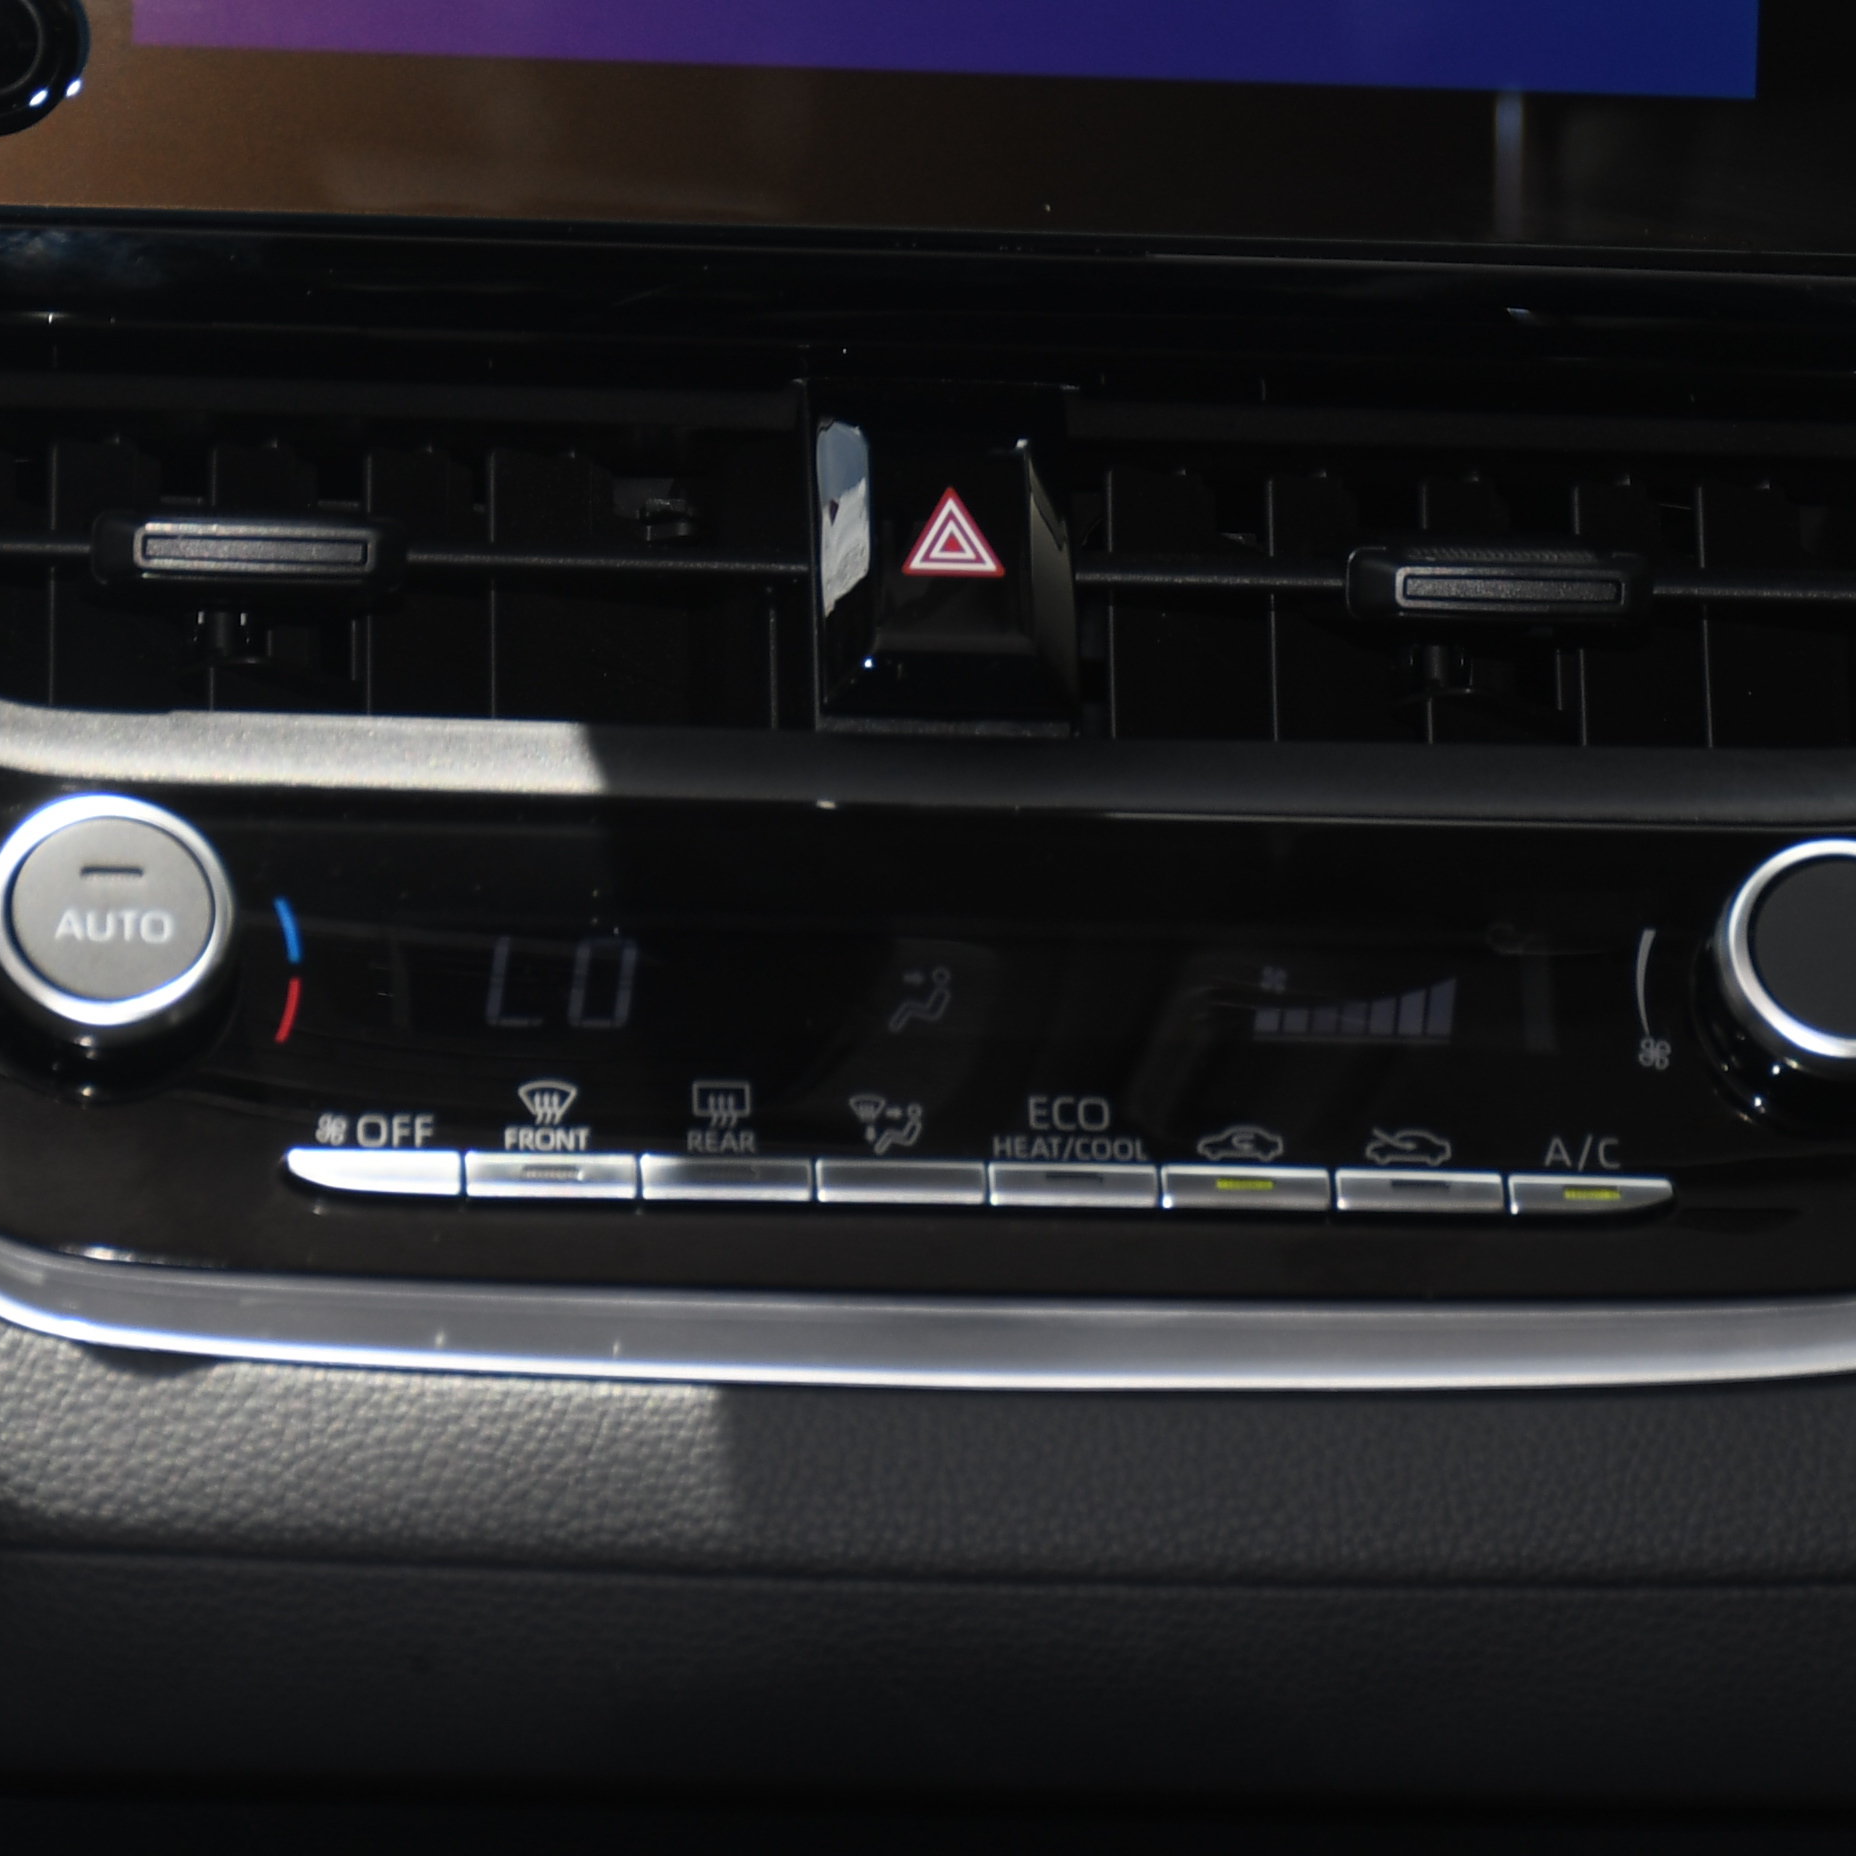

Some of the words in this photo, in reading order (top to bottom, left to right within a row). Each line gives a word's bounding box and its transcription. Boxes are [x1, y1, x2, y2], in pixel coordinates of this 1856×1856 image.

[55, 909, 174, 943] AUTO
[1028, 1095, 1110, 1132] ECO
[356, 1115, 434, 1148] OFF
[505, 1128, 590, 1152] FRONT
[687, 1130, 756, 1153] REAR
[993, 1136, 1148, 1162] HEAT/COOL
[1546, 1138, 1620, 1171] A/C
